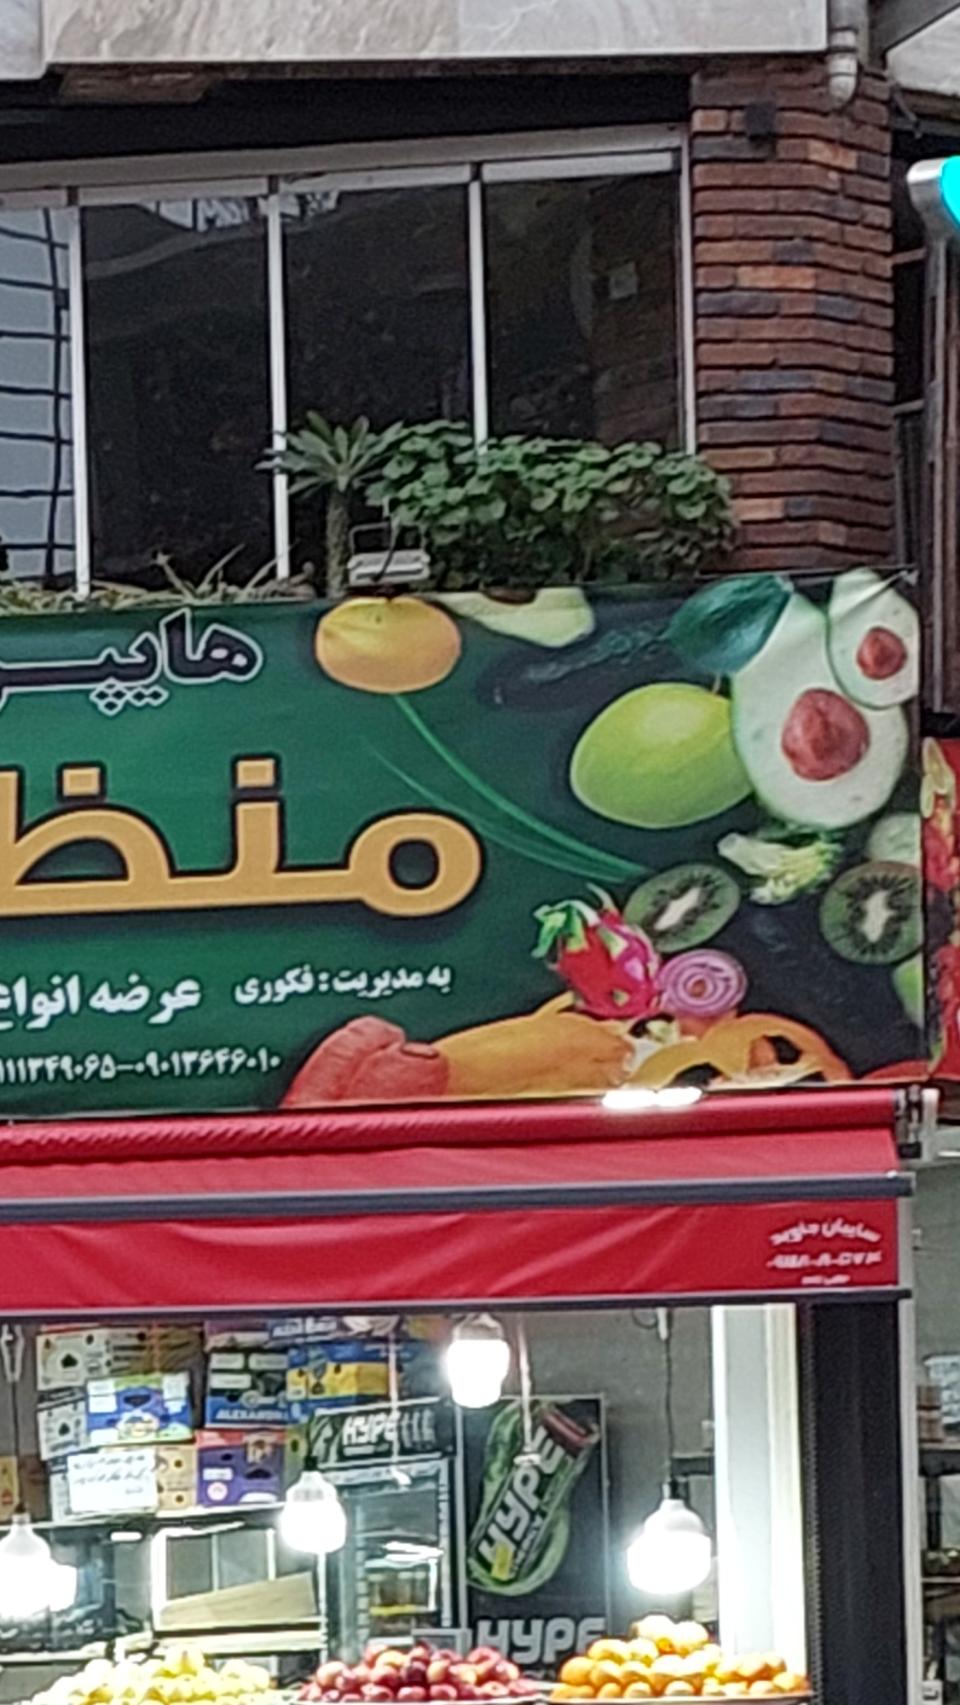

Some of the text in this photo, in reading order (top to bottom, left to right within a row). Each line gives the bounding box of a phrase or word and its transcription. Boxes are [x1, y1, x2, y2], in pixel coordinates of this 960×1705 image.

[89, 974, 201, 1024] عرضه
[234, 963, 315, 1004] فکوری
[427, 965, 452, 993] به
